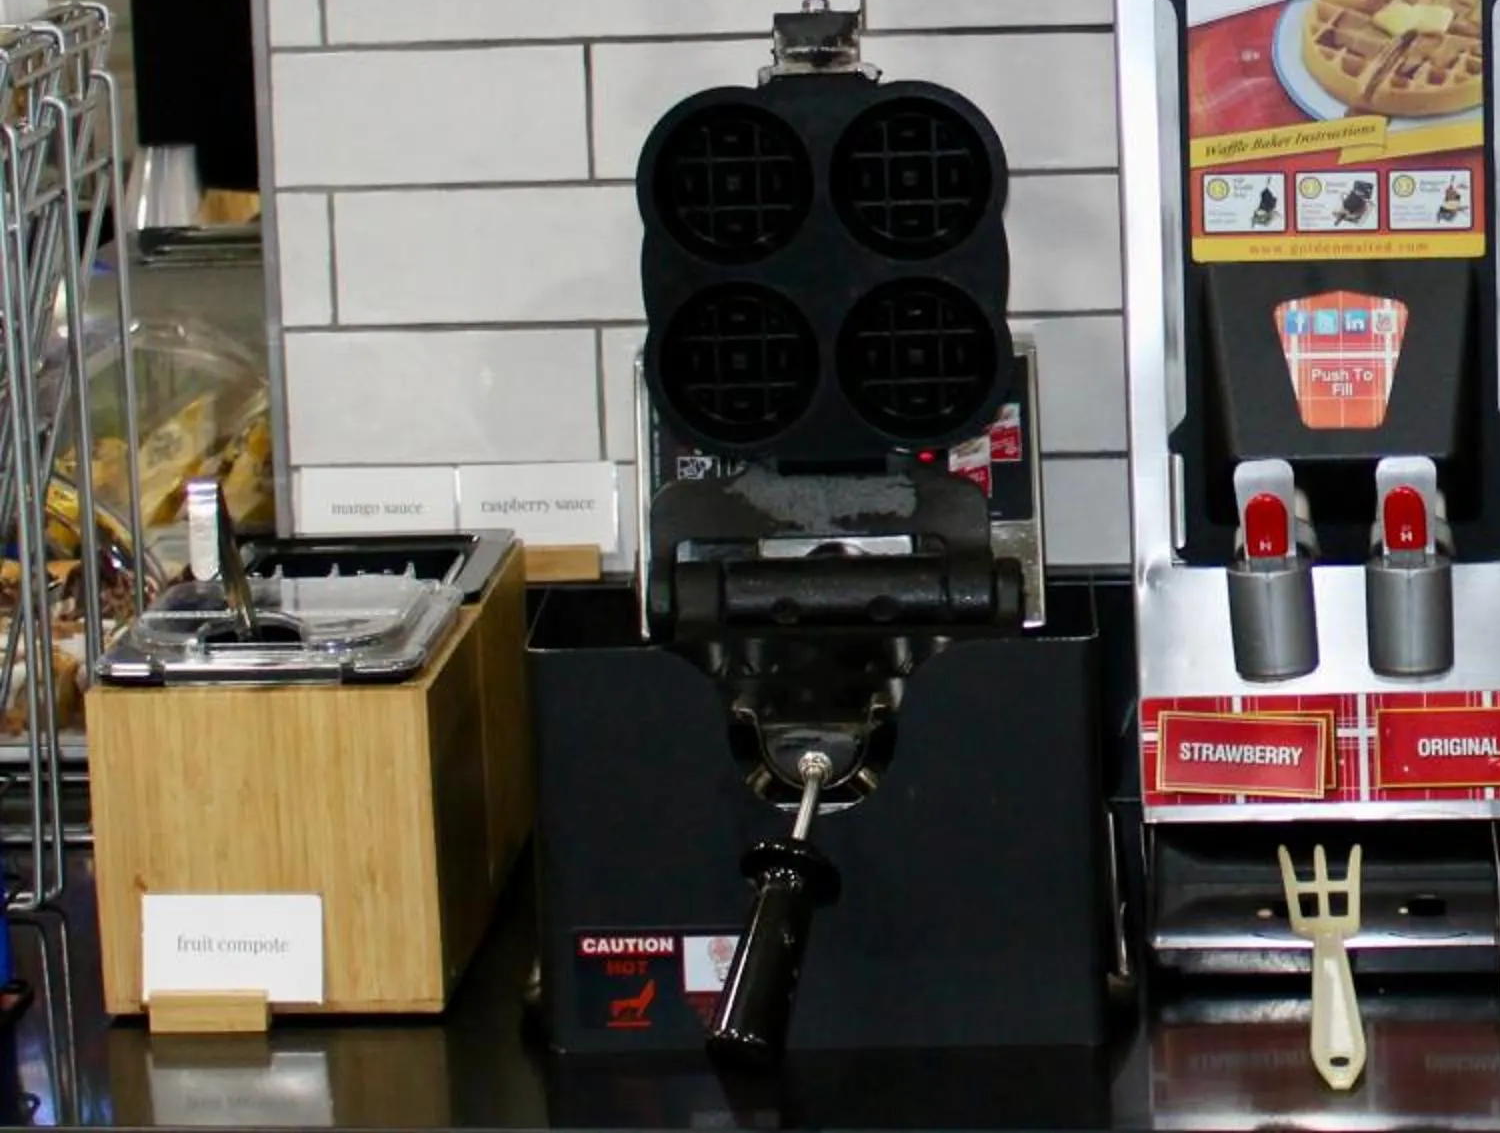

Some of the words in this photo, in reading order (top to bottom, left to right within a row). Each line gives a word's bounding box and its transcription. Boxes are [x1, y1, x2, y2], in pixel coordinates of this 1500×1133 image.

[1204, 139, 1249, 157] Waffle
[1250, 132, 1291, 151] Baker
[1295, 123, 1377, 145] Instructions
[1311, 367, 1349, 383] Push
[1352, 367, 1375, 382] To
[1332, 383, 1354, 397] Fill
[331, 502, 380, 517] mango
[383, 501, 424, 515] sauce
[481, 497, 551, 514] raspberry
[554, 497, 595, 511] sauce
[1179, 741, 1304, 766] STRAWBERRY
[177, 934, 214, 953] fruit
[217, 937, 290, 955] compote
[581, 937, 675, 954] CAUTION
[606, 960, 649, 976] HOT
